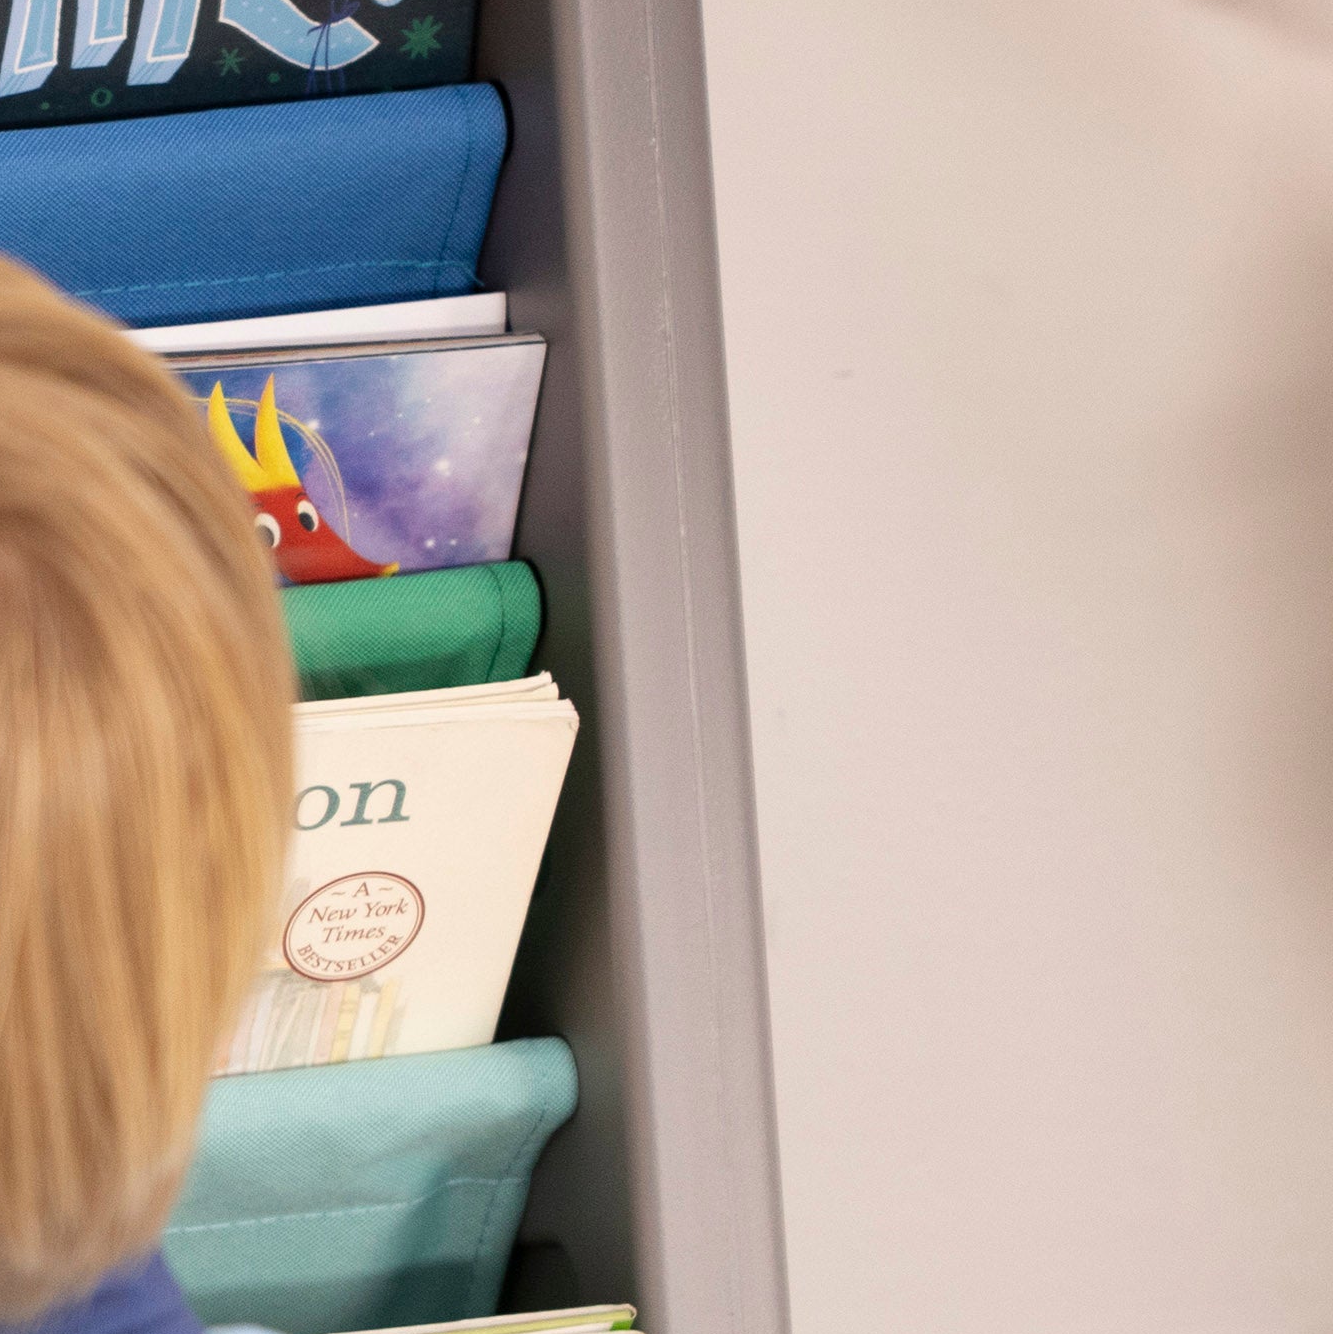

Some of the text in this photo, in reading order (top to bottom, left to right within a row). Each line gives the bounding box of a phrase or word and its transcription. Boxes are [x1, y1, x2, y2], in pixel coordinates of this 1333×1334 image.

[352, 881, 370, 898] A
[307, 897, 409, 924] New York
[322, 925, 387, 944] Times
[296, 933, 404, 973] BESTSELLER
